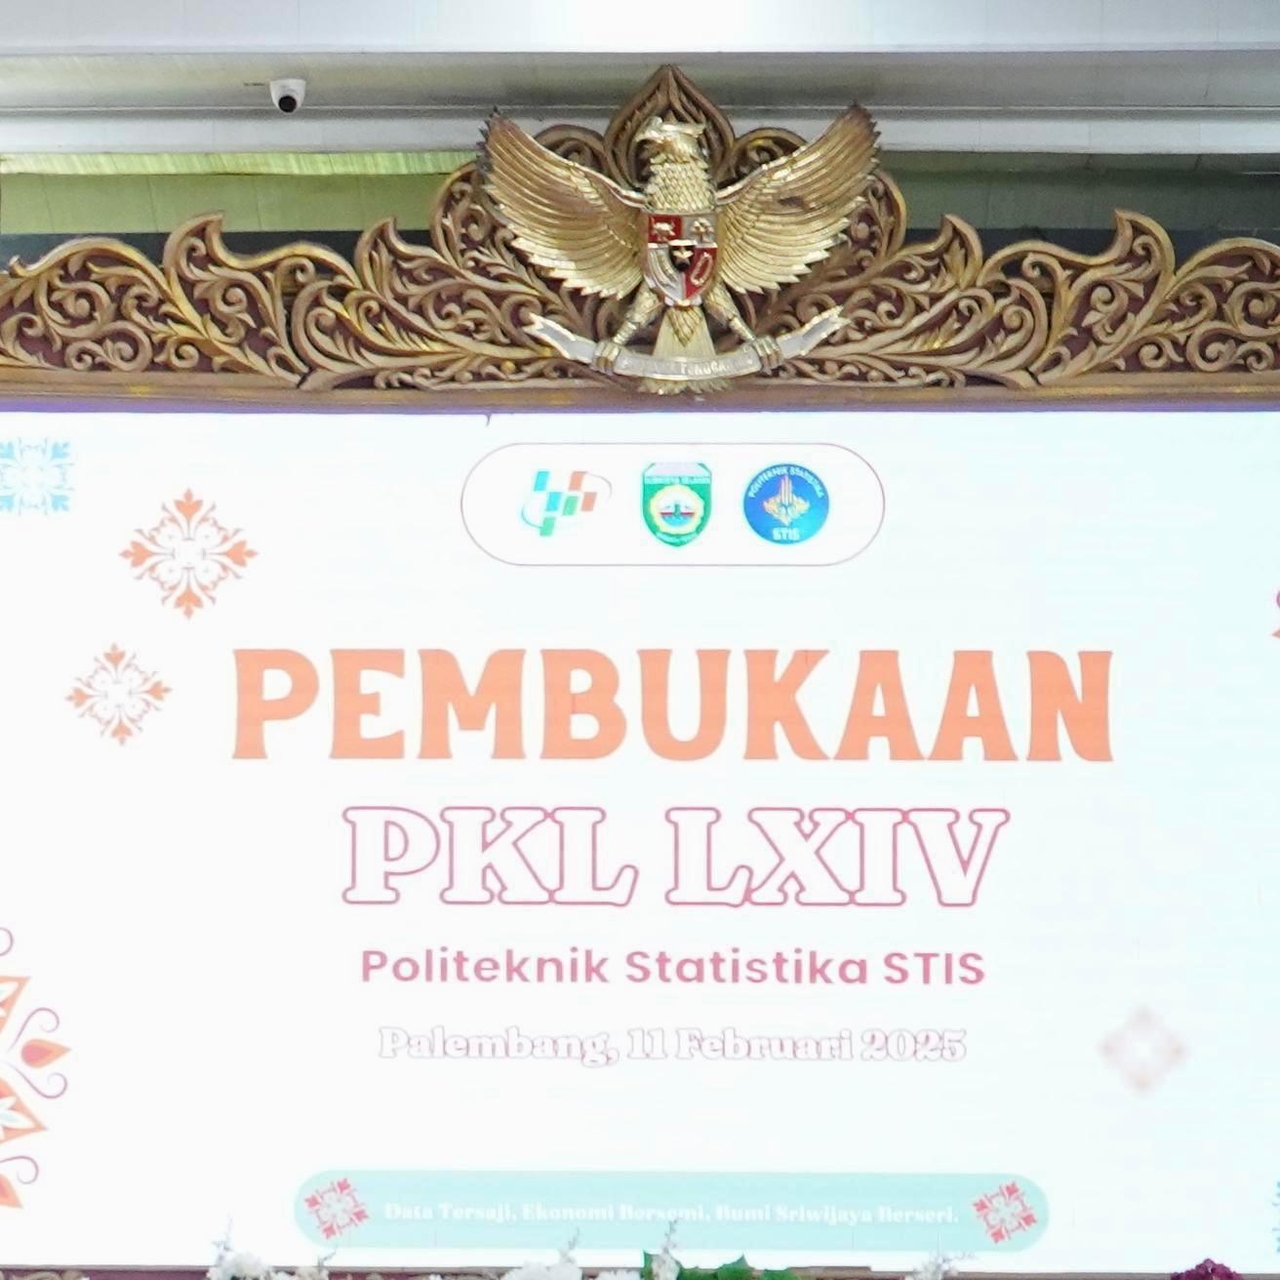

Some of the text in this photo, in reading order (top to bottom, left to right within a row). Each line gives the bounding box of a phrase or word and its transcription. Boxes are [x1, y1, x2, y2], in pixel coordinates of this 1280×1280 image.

[231, 648, 1114, 762] PEMBUKAAN
[341, 806, 1010, 908] PKL LXIV
[360, 946, 985, 986] Politeknik Statistika STIS
[379, 1026, 967, 1068] Palembang, 11 Februari 2025
